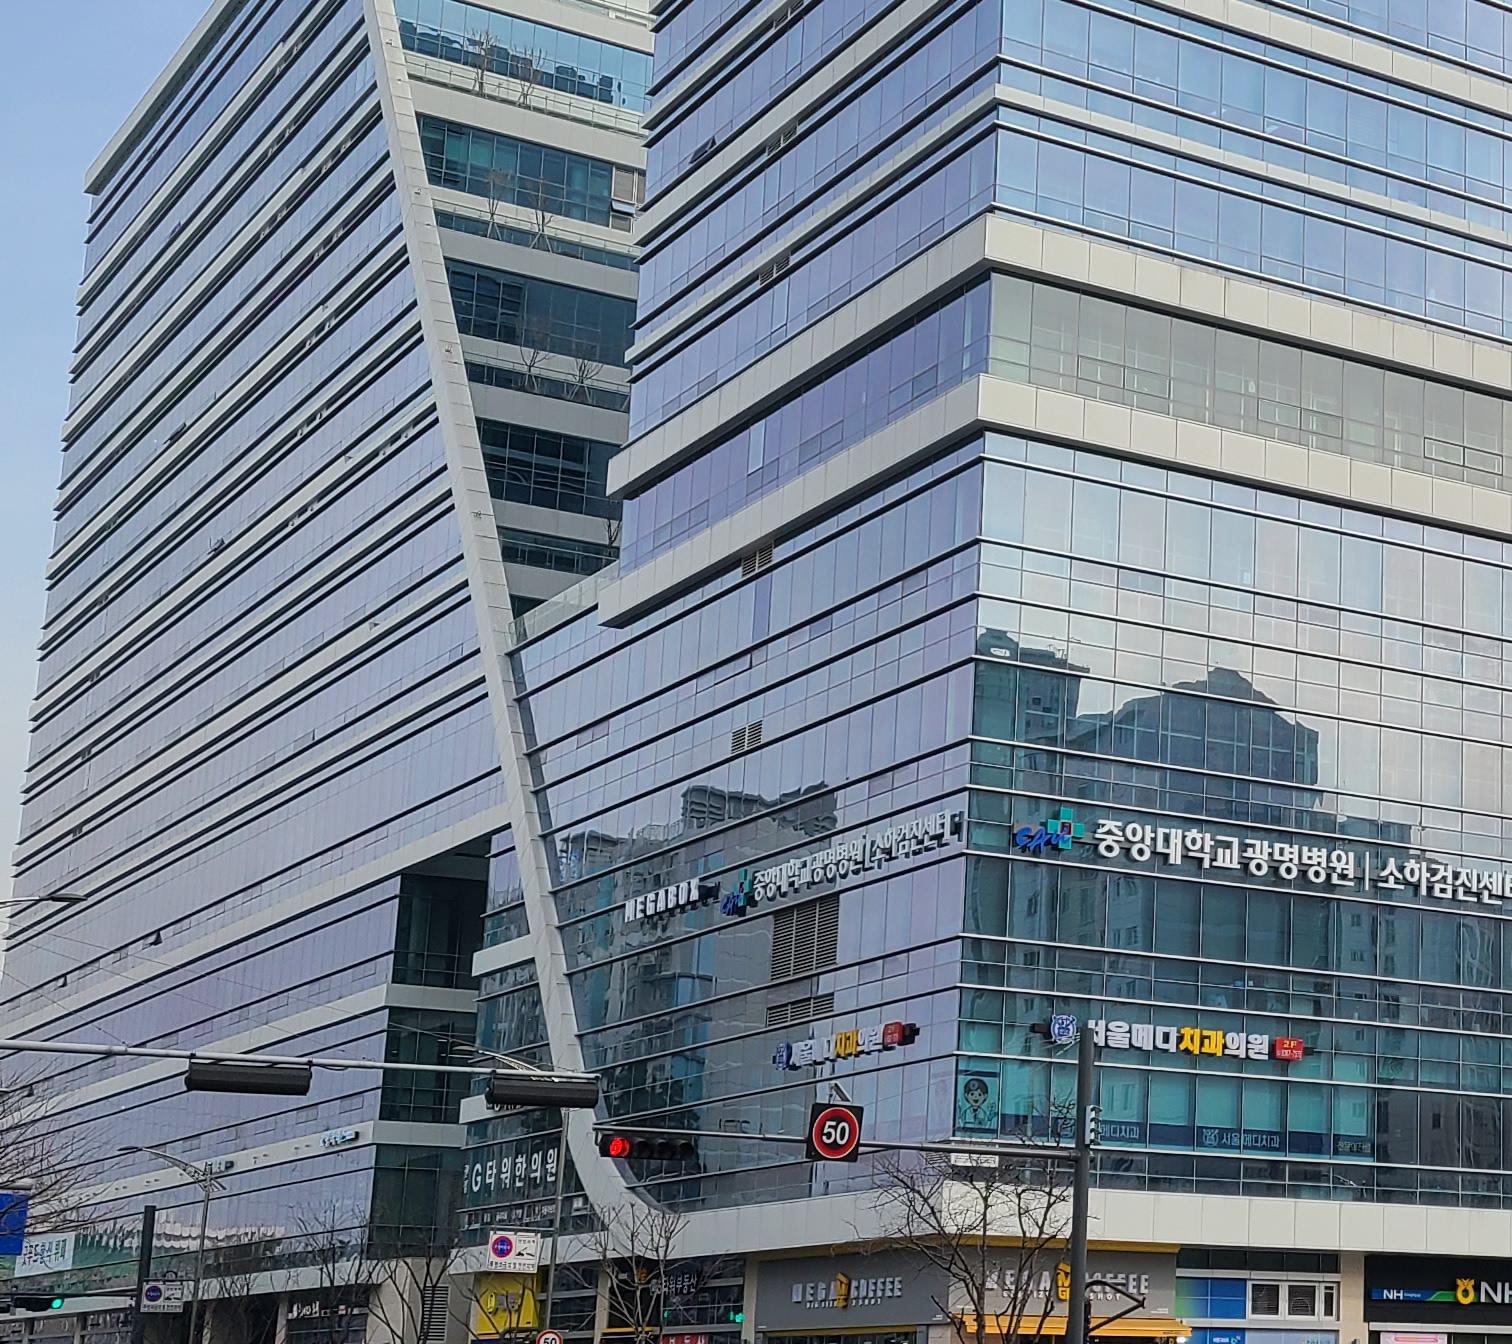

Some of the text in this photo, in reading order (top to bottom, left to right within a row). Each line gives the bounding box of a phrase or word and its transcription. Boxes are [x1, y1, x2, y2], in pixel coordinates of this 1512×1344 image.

[1094, 819, 1355, 887] 중앙대학교광명병원
[624, 879, 699, 923] MEGABOX
[822, 1121, 849, 1145] 50
[1221, 1131, 1280, 1149] 서울메디치과
[471, 1147, 559, 1193] G타워한의원
[851, 1277, 902, 1299] COFFEE
[1383, 1289, 1404, 1301] NH
